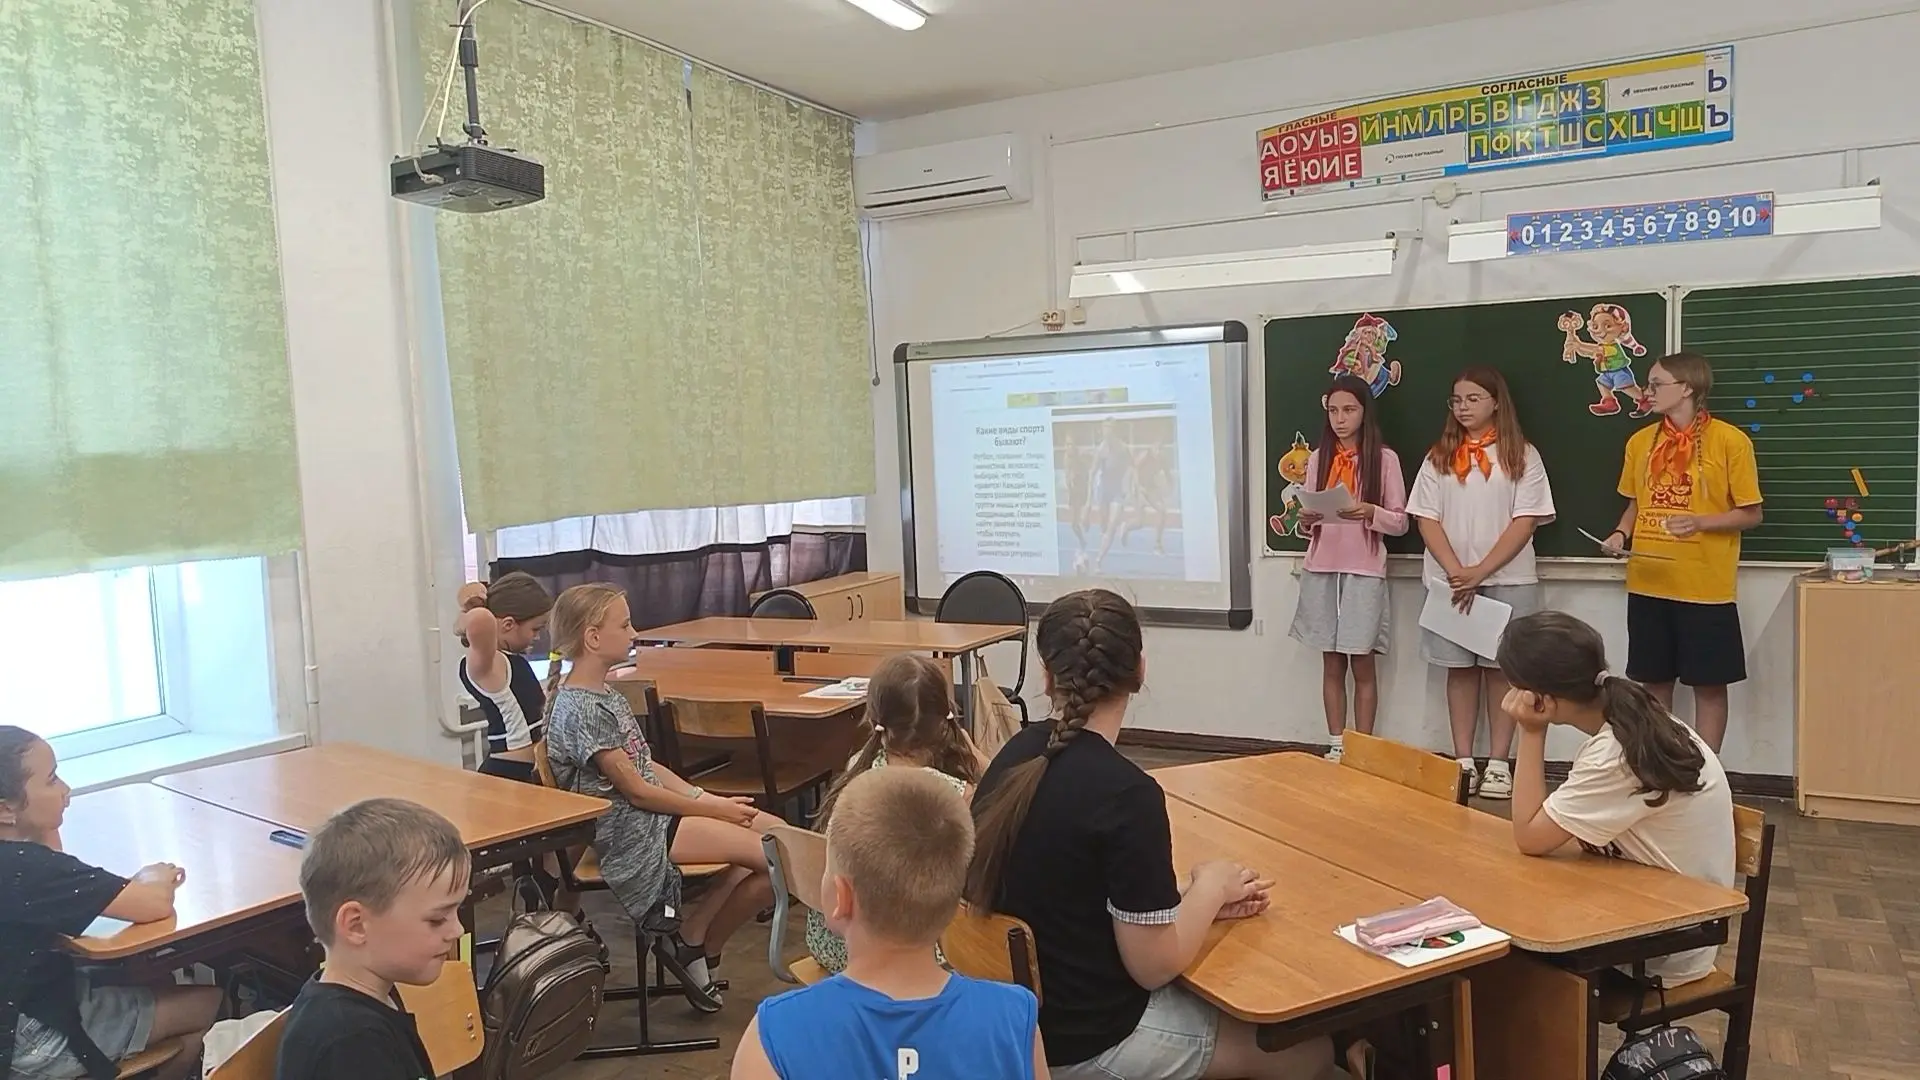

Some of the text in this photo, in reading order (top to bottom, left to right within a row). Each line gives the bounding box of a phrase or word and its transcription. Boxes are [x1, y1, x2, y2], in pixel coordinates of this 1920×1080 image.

[1481, 74, 1568, 96] СОГЛАСНЫЕ
[1708, 69, 1728, 93] Ь
[1261, 86, 1602, 161] А О У Ы Э Й Н М Л Р Б В Г Д Ж З
[1278, 112, 1337, 133] ГЛАСНЫЕ
[1706, 104, 1729, 127] Ъ
[1470, 134, 1488, 158] П
[1491, 132, 1511, 155] Ф
[1515, 129, 1532, 152] К
[1538, 125, 1556, 148] Т
[1560, 122, 1581, 146] Ш
[1585, 119, 1603, 142] С
[1608, 116, 1627, 140] Х
[1632, 112, 1653, 139] Ц
[1657, 109, 1676, 132] Ч
[1680, 106, 1704, 132] Щ
[1264, 153, 1358, 187] Я Ё Ю И Е
[1521, 206, 1756, 245] 0 1 2 3 4 5 6 7 8 9 10
[976, 425, 1045, 435] Какие виды спорта
